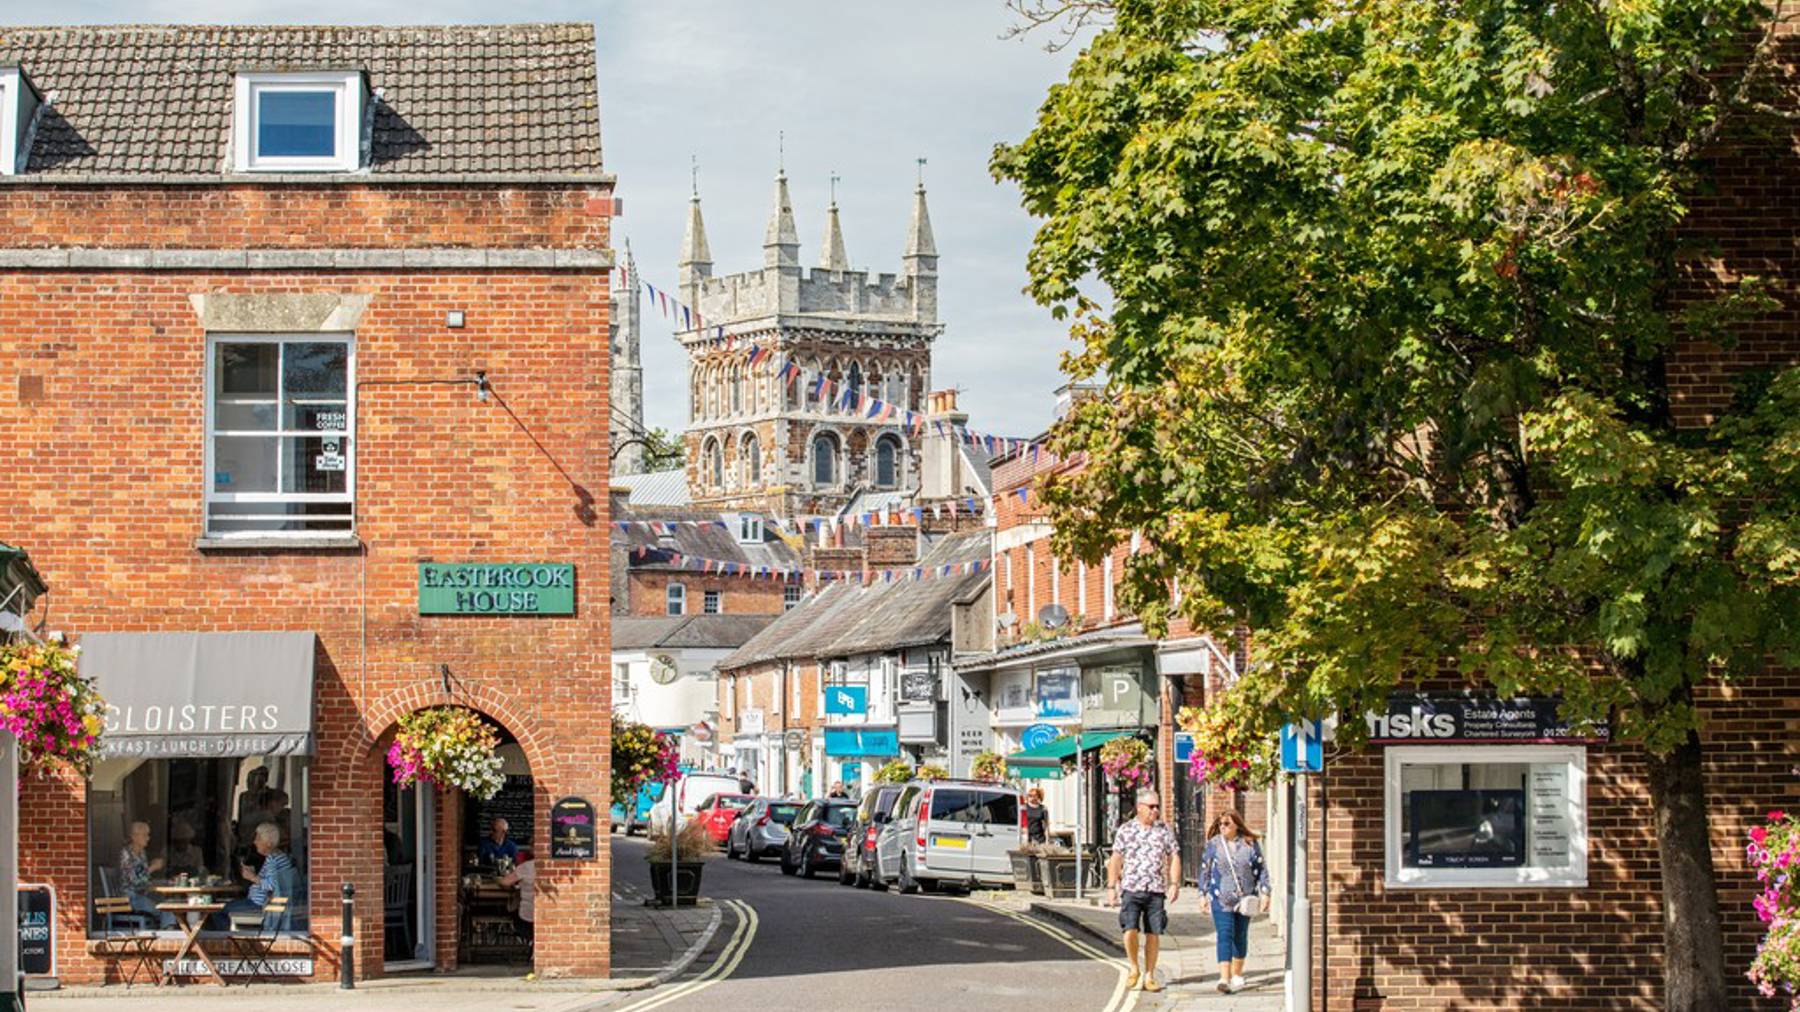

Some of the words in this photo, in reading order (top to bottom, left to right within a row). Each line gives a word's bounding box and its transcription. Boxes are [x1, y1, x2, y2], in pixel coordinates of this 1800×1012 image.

[316, 412, 346, 421] FRESH
[316, 421, 346, 430] COFFEE
[424, 567, 571, 588] EASTBROOK
[456, 591, 539, 611] HOUSE
[1113, 679, 1130, 704] P
[104, 704, 279, 732] CLOISTERS
[1463, 709, 1497, 719] Estate
[1498, 709, 1537, 721] Agents
[1463, 721, 1494, 729] Property
[1496, 721, 1537, 729] Consultants
[1501, 730, 1537, 738] Surveyors
[108, 740, 151, 753] KFAST
[160, 740, 208, 752] LUNCH
[216, 739, 268, 751] COFFEE
[278, 738, 305, 751] BAR
